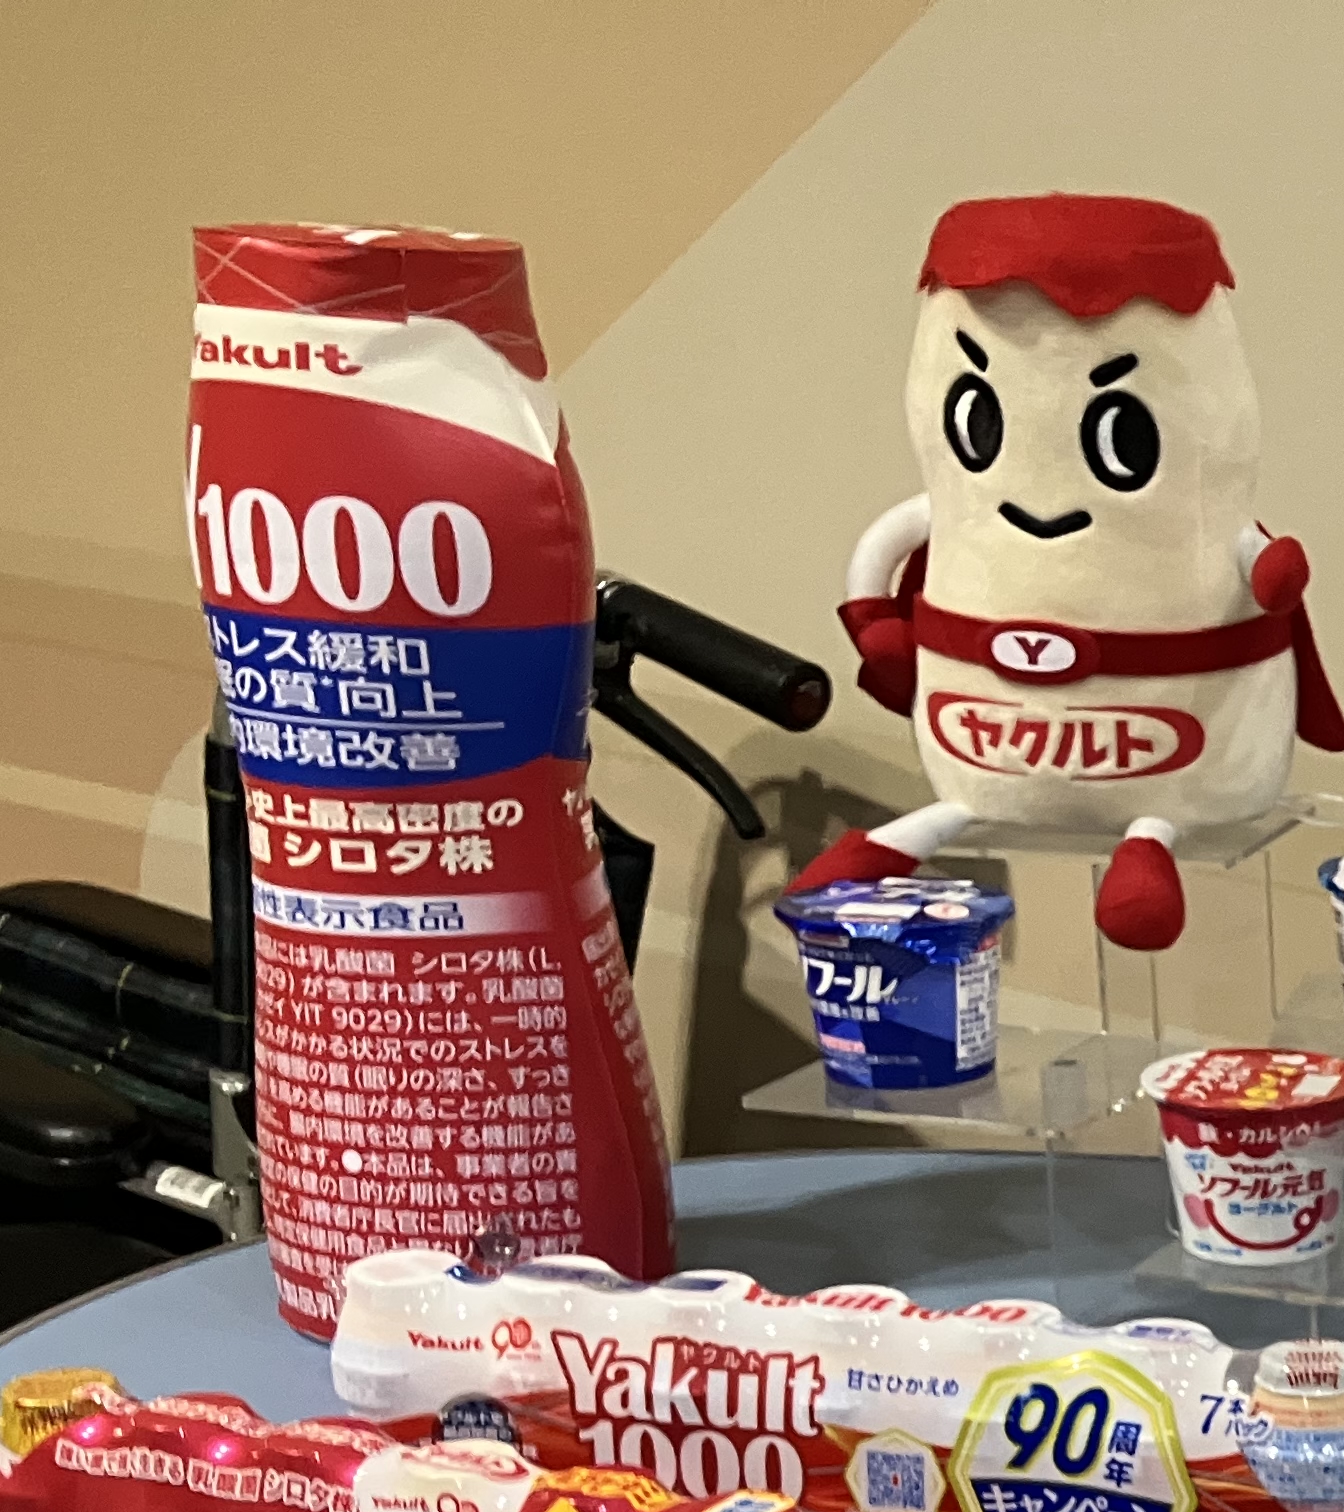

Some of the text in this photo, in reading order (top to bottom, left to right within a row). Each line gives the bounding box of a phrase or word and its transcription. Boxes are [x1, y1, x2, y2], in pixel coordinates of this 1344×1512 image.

[194, 333, 363, 377] akult
[206, 613, 431, 677] トレス緩和
[1013, 636, 1051, 666] Y
[958, 708, 1157, 771] ヤクルト
[254, 880, 465, 933] 性表示食品
[408, 1330, 485, 1353] Yakult
[550, 1329, 827, 1438] Yakult
[846, 1366, 960, 1397] 甘さひかえめ
[1002, 1381, 1111, 1478] 90
[577, 1421, 803, 1502] 1000
